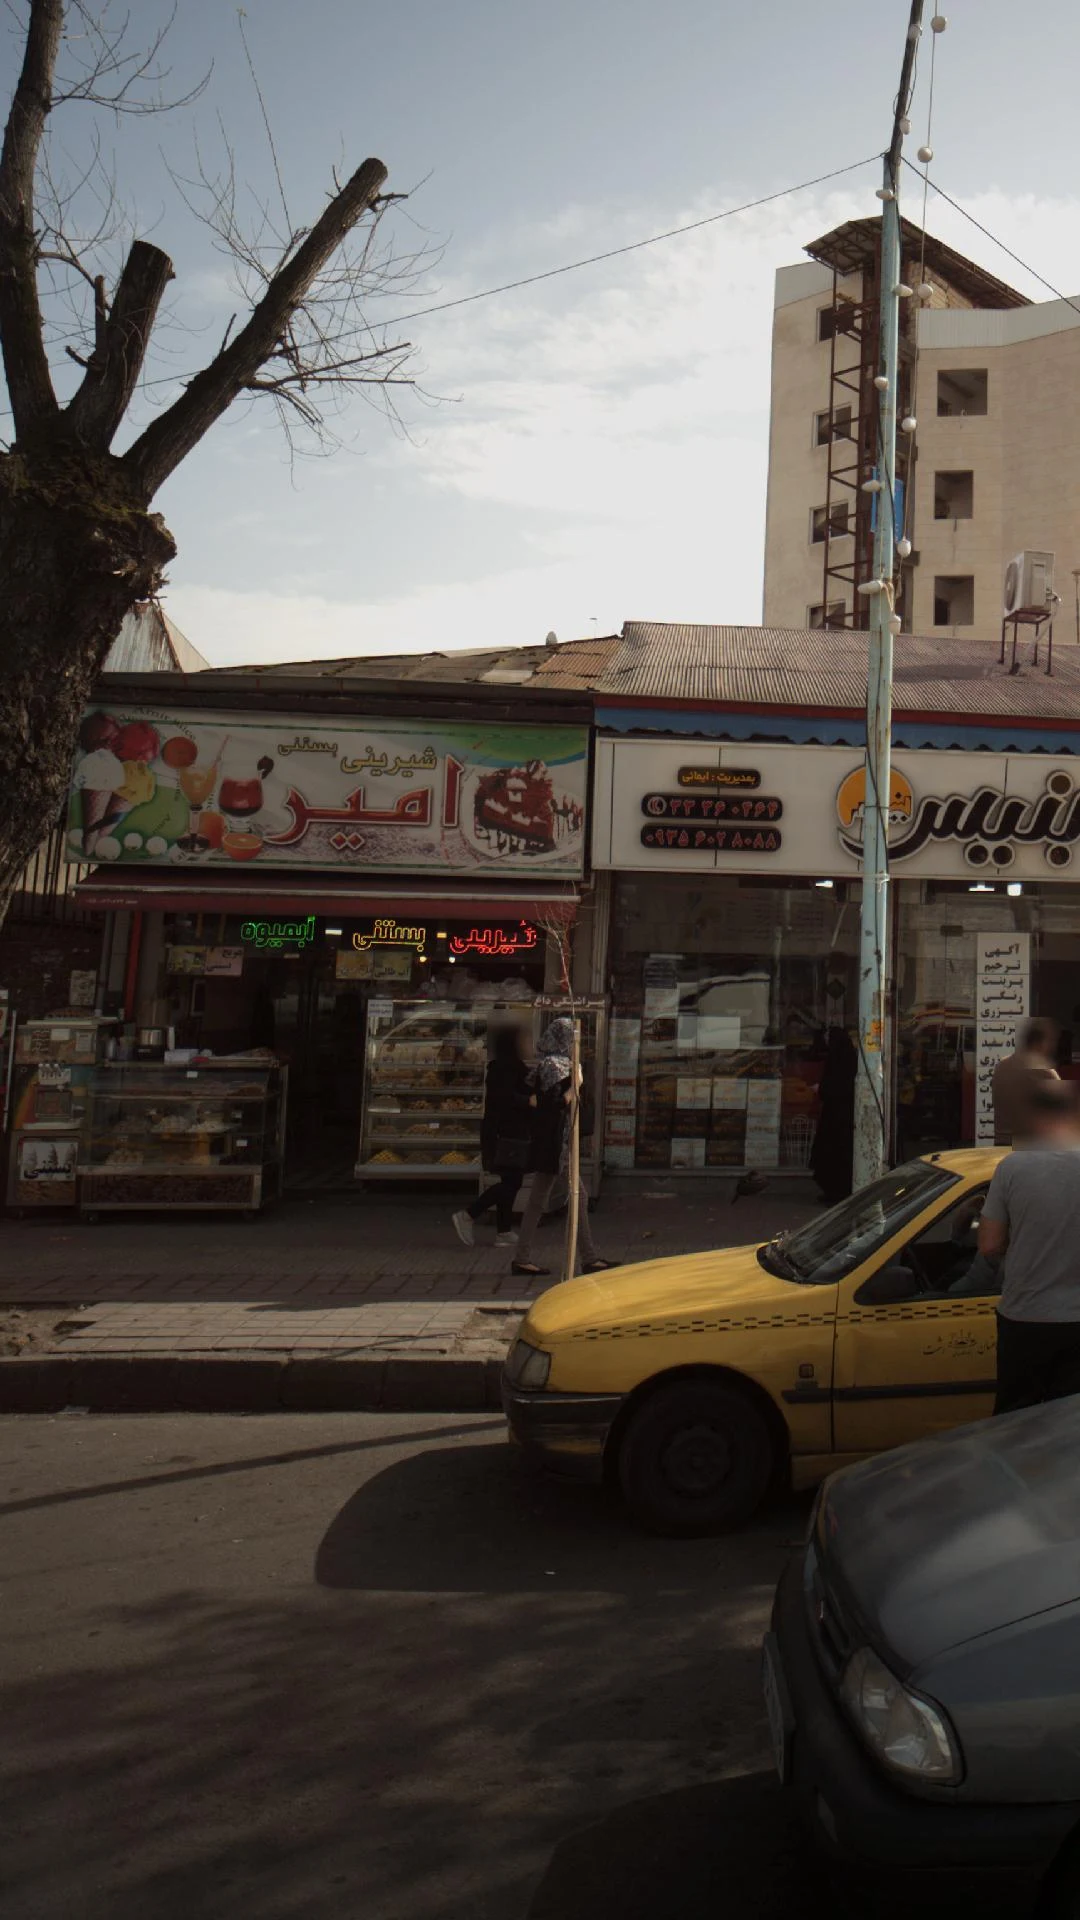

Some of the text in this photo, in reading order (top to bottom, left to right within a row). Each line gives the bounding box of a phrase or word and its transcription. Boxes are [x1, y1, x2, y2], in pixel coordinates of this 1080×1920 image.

[278, 736, 338, 757] بستنی
[340, 746, 437, 777] شیرینی
[262, 753, 465, 851] امیر
[352, 918, 427, 952] بستنی
[984, 943, 1020, 958] آگهی
[984, 959, 1021, 973] ترحیم
[982, 976, 1024, 988] پرینت
[983, 990, 1022, 1003] رنگی
[981, 1006, 1024, 1019] لیزری
[23, 1159, 73, 1180] بستنی
